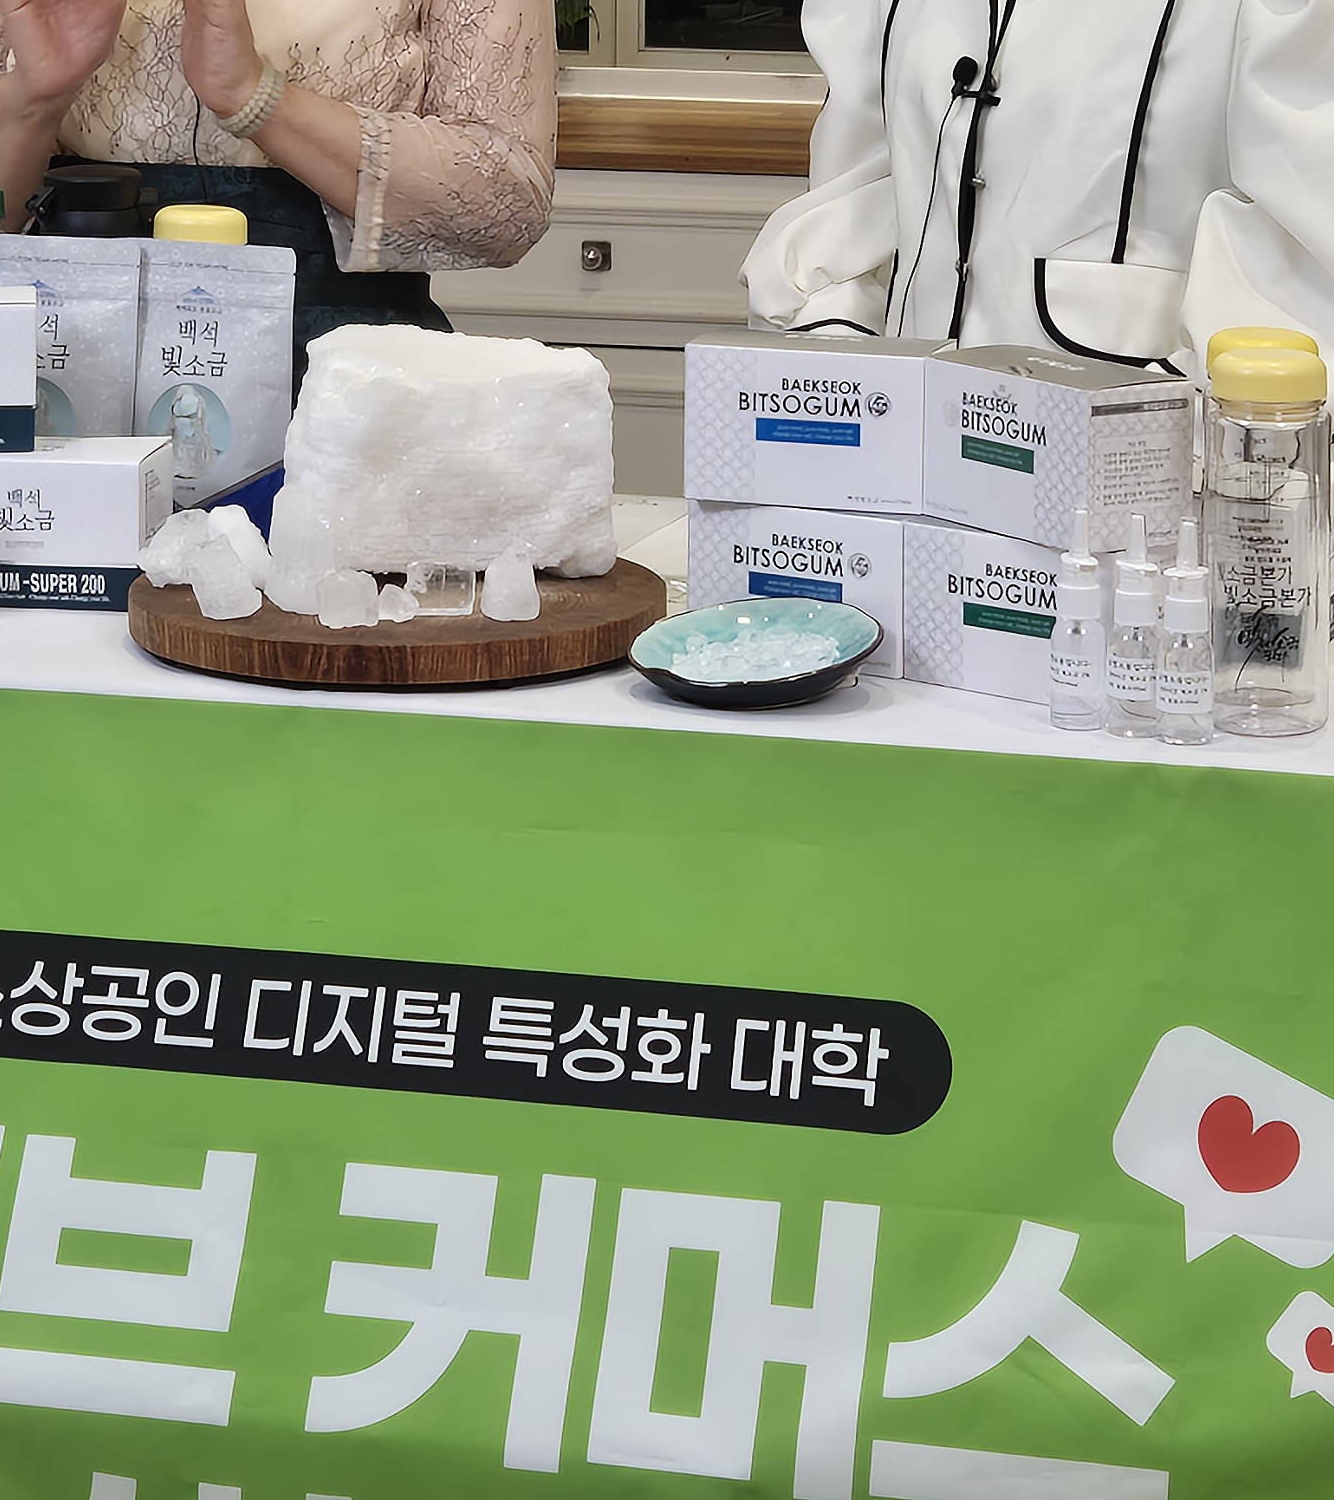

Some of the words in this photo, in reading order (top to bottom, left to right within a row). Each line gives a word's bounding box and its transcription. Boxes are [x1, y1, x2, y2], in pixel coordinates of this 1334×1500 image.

[179, 319, 219, 348] 백석
[161, 345, 229, 378] 빛소금
[781, 377, 862, 396] BAEKSEOK
[739, 391, 862, 419] BITSOGUM
[962, 391, 1018, 417] BAEKSEOK
[961, 408, 1048, 447] BITSOGUM
[6, 488, 42, 508] 백석
[771, 533, 844, 555] BAEKSEOK
[733, 544, 844, 578] BITSOGUM
[81, 573, 106, 595] 200
[985, 563, 1058, 588] BAEKSEOK
[947, 573, 1058, 611] BITSOGUM
[242, 979, 461, 1069] 디지털
[482, 996, 711, 1091] 특성화
[729, 1017, 890, 1107] 대학
[305, 1160, 1176, 1500] 커머스
